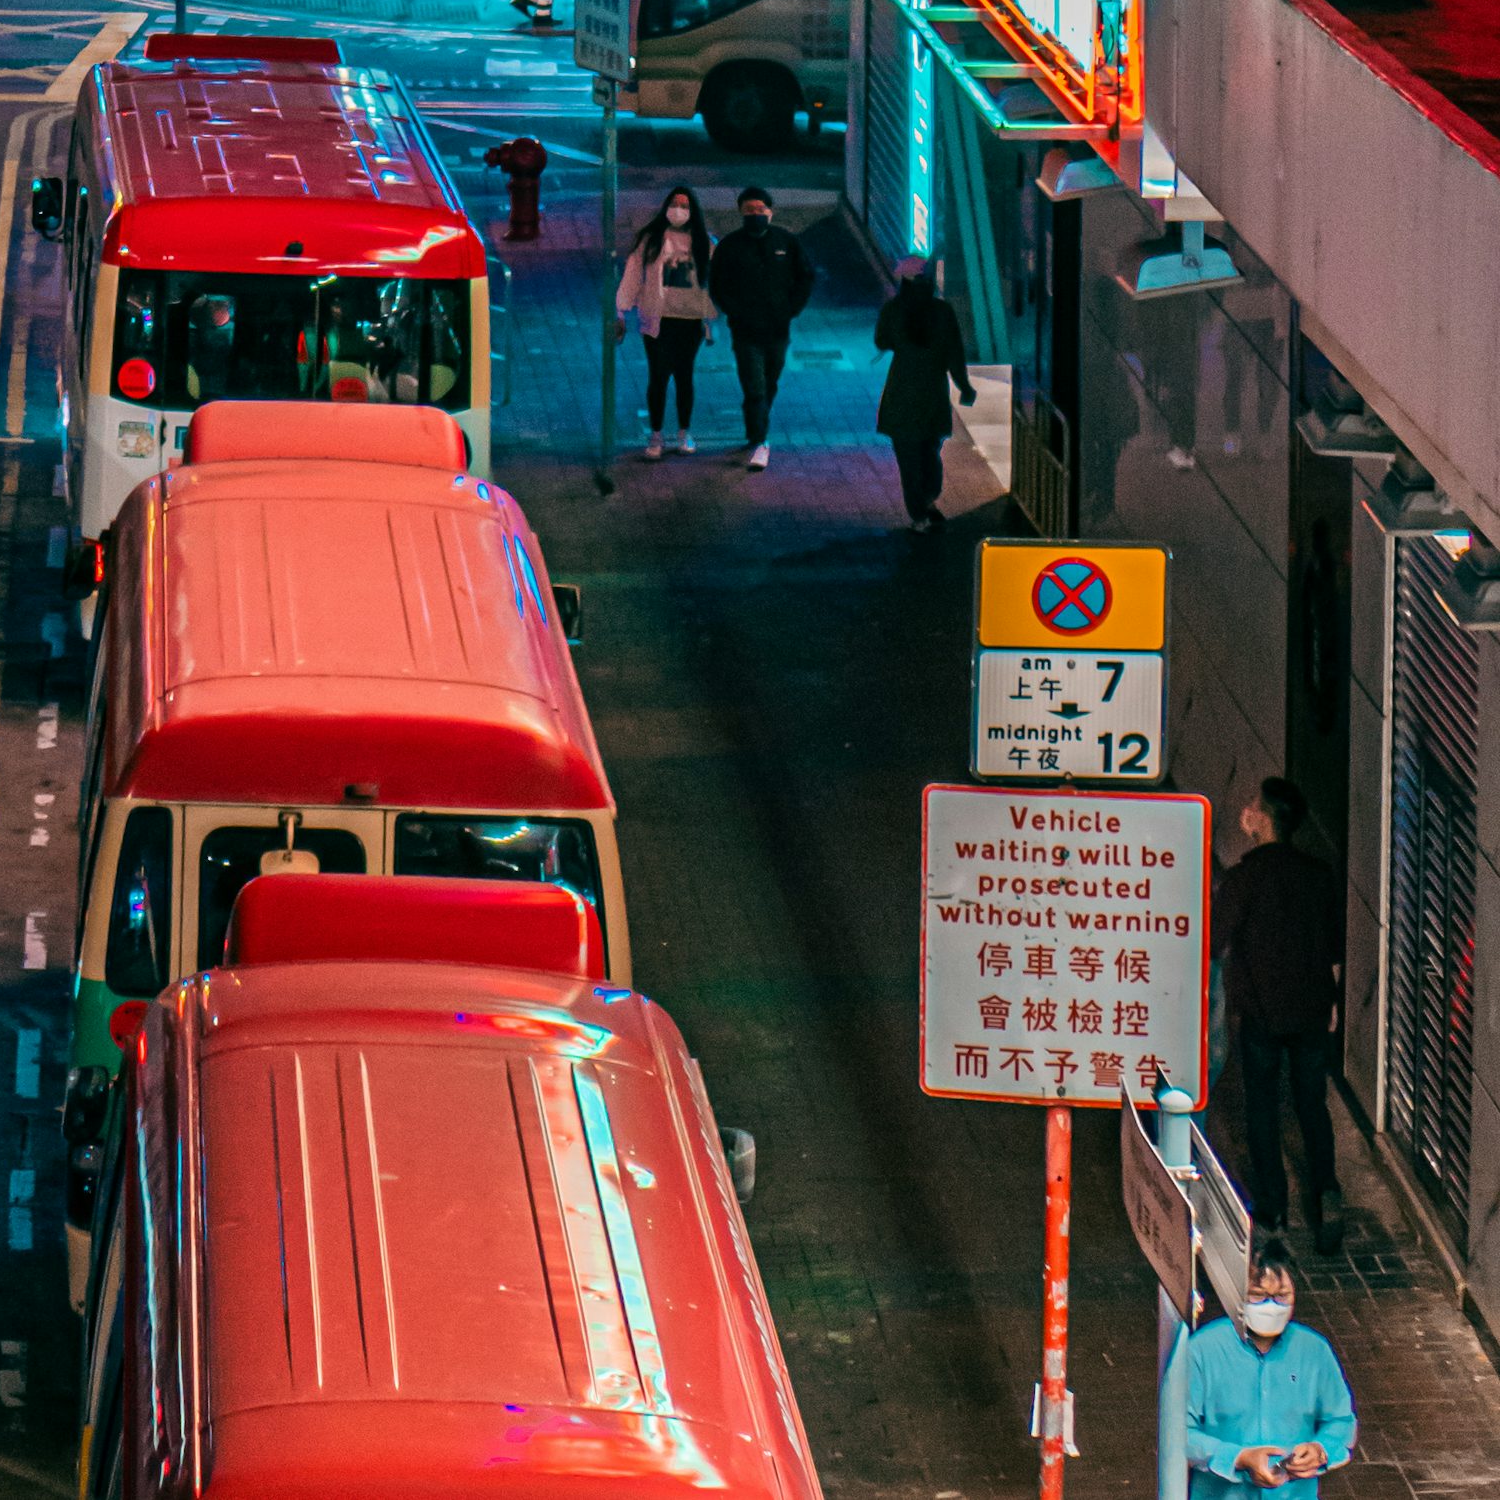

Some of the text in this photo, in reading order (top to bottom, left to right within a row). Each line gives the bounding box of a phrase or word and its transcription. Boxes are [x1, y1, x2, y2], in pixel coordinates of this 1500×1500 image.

[1008, 675, 1063, 702] 上午
[1020, 657, 1126, 703] am 7
[986, 722, 1151, 775] midnight 12
[1006, 746, 1062, 772] 午夜
[1009, 804, 1122, 834] Vehicle
[955, 841, 1176, 869] waiting will be
[977, 873, 1152, 903] prosecuted
[938, 902, 1191, 938] without warning
[976, 940, 1152, 984] 停車等候
[976, 994, 1151, 1039] 會被檢控
[953, 1043, 1173, 1091] 而不予警告
